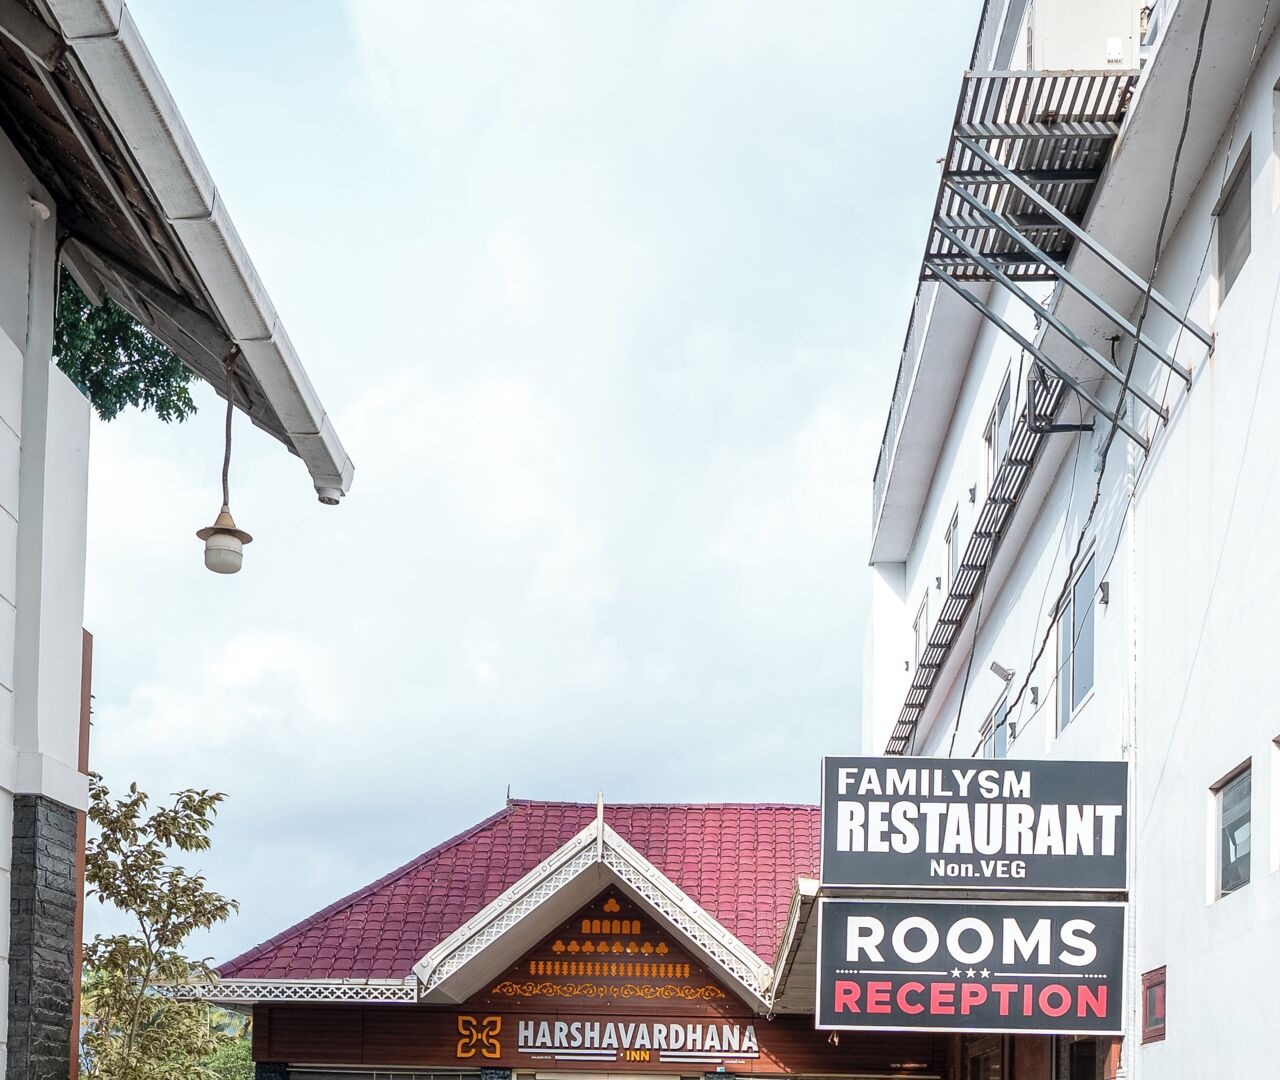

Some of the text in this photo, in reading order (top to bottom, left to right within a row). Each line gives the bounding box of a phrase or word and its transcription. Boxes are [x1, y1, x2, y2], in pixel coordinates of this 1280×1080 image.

[836, 801, 1123, 857] RESTAURANT
[846, 915, 1098, 966] ROOMS
[834, 980, 1108, 1018] RECEPTION
[518, 1020, 760, 1052] HARSHAVARDHANA
[626, 1050, 650, 1062] INN
